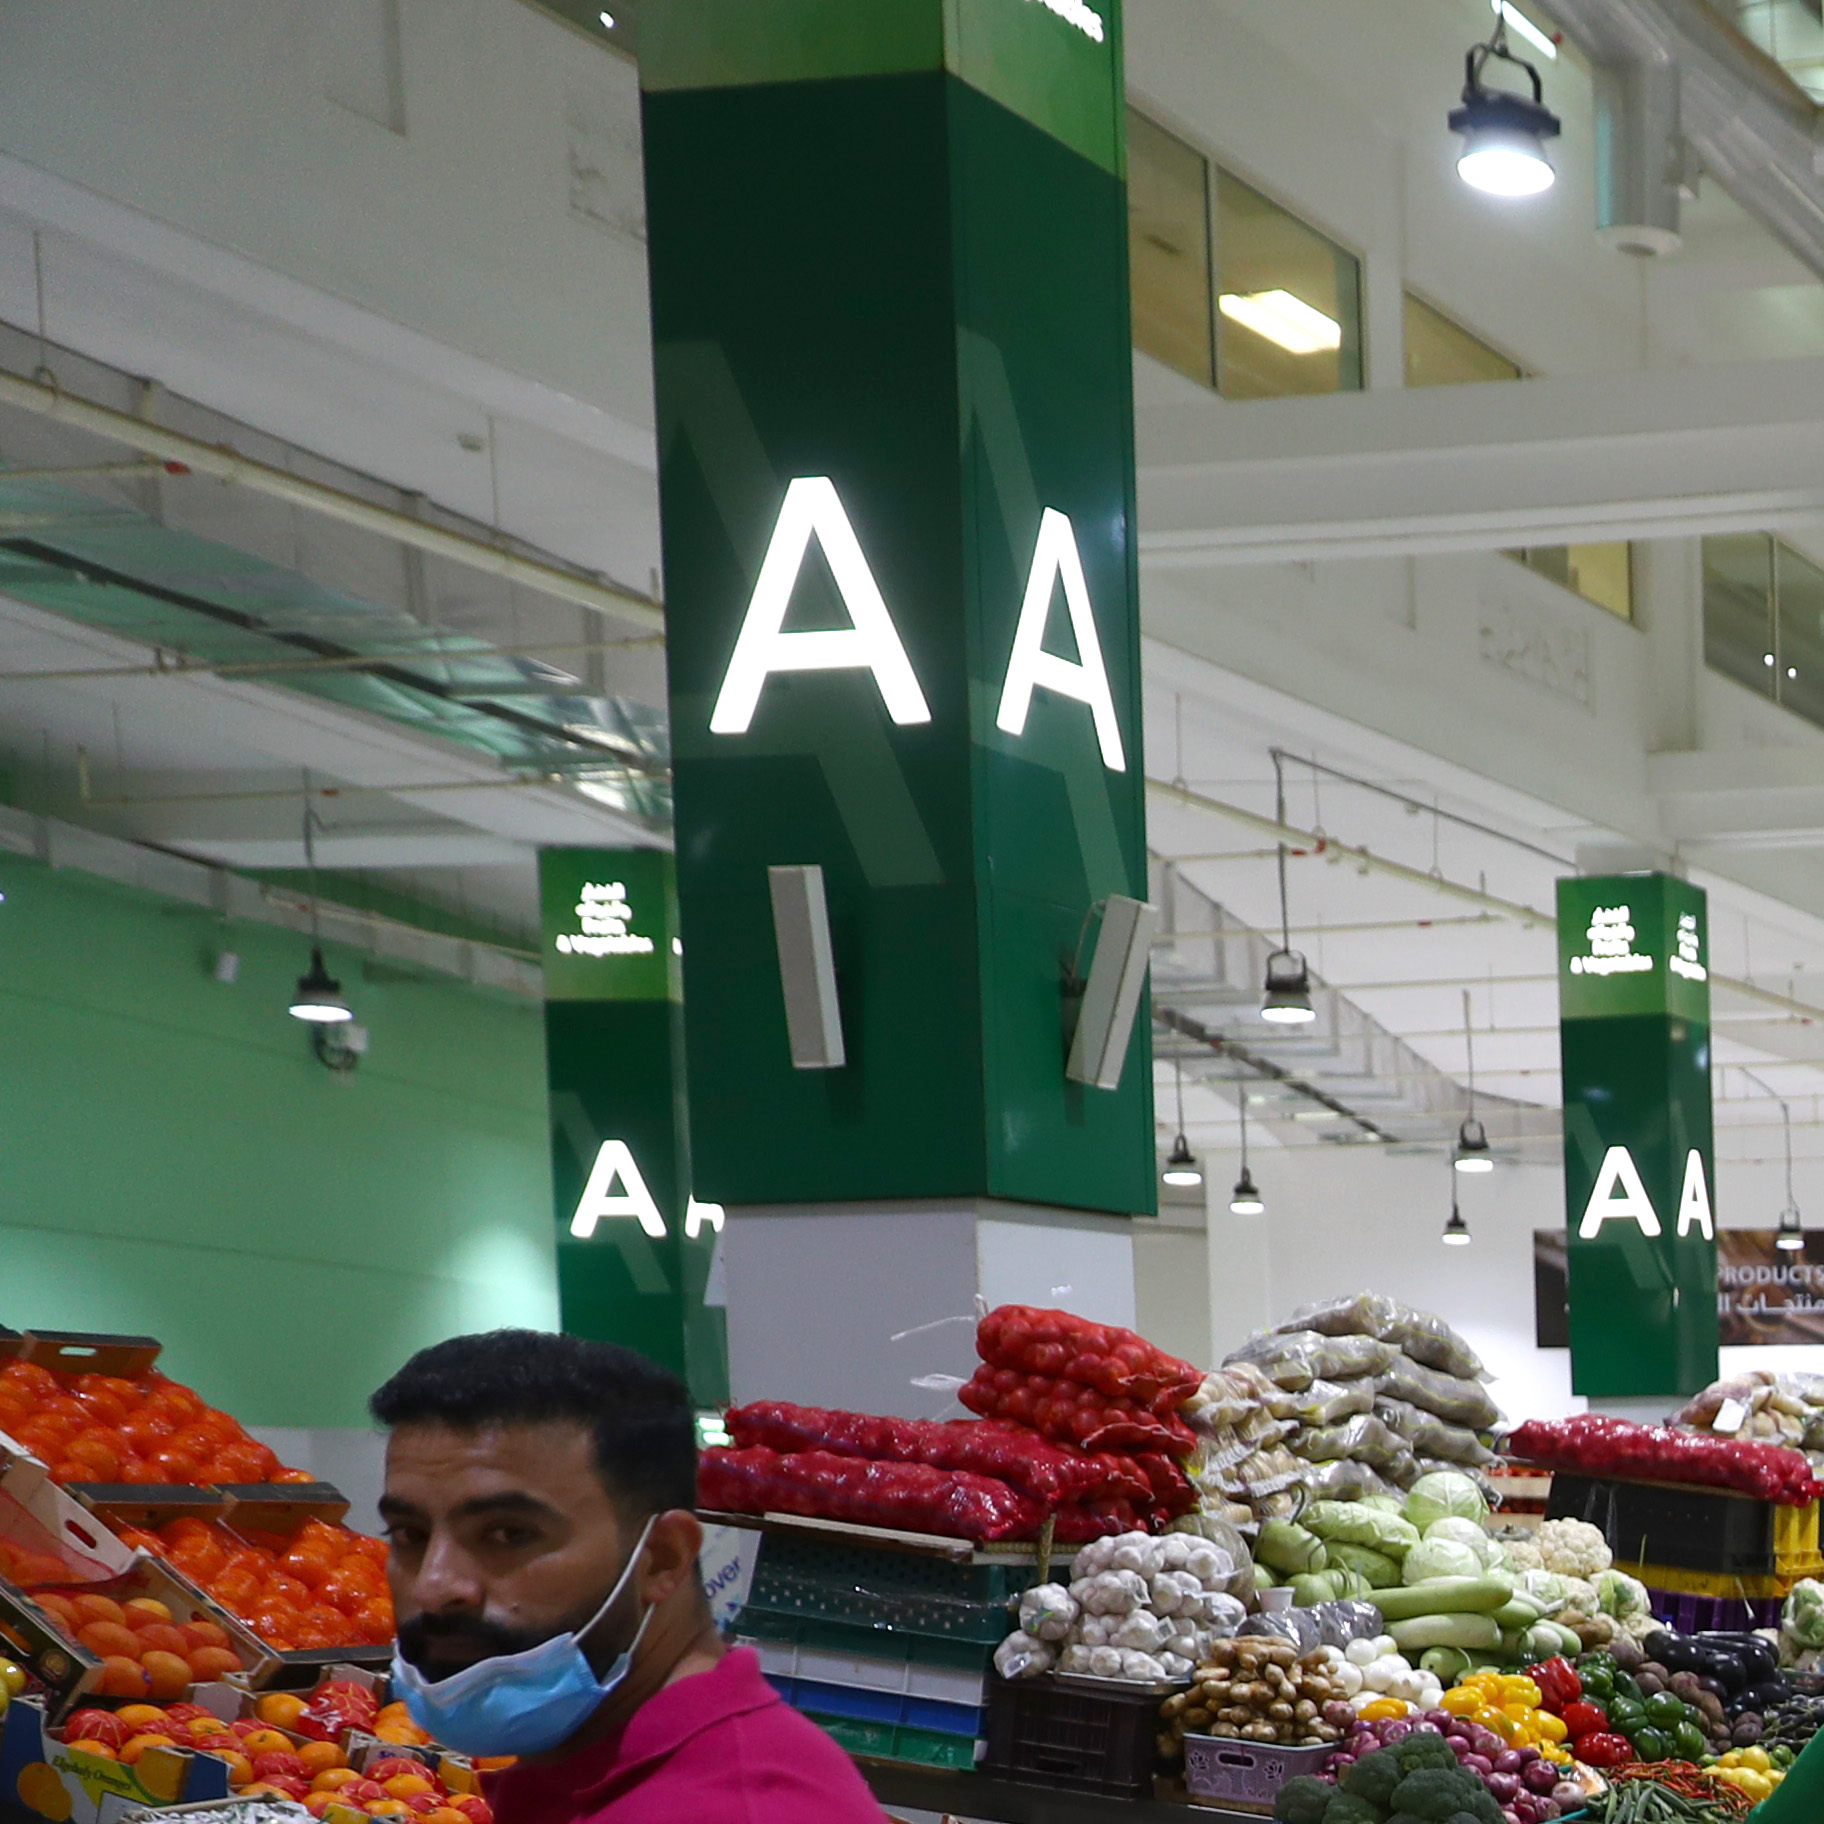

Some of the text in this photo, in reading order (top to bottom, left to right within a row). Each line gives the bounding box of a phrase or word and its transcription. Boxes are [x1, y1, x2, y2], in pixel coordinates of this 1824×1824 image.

[709, 476, 931, 734] A
[996, 507, 1126, 772] A
[570, 1140, 667, 1238] A
[1579, 1146, 1661, 1239] A
[1677, 1149, 1713, 1240] A
